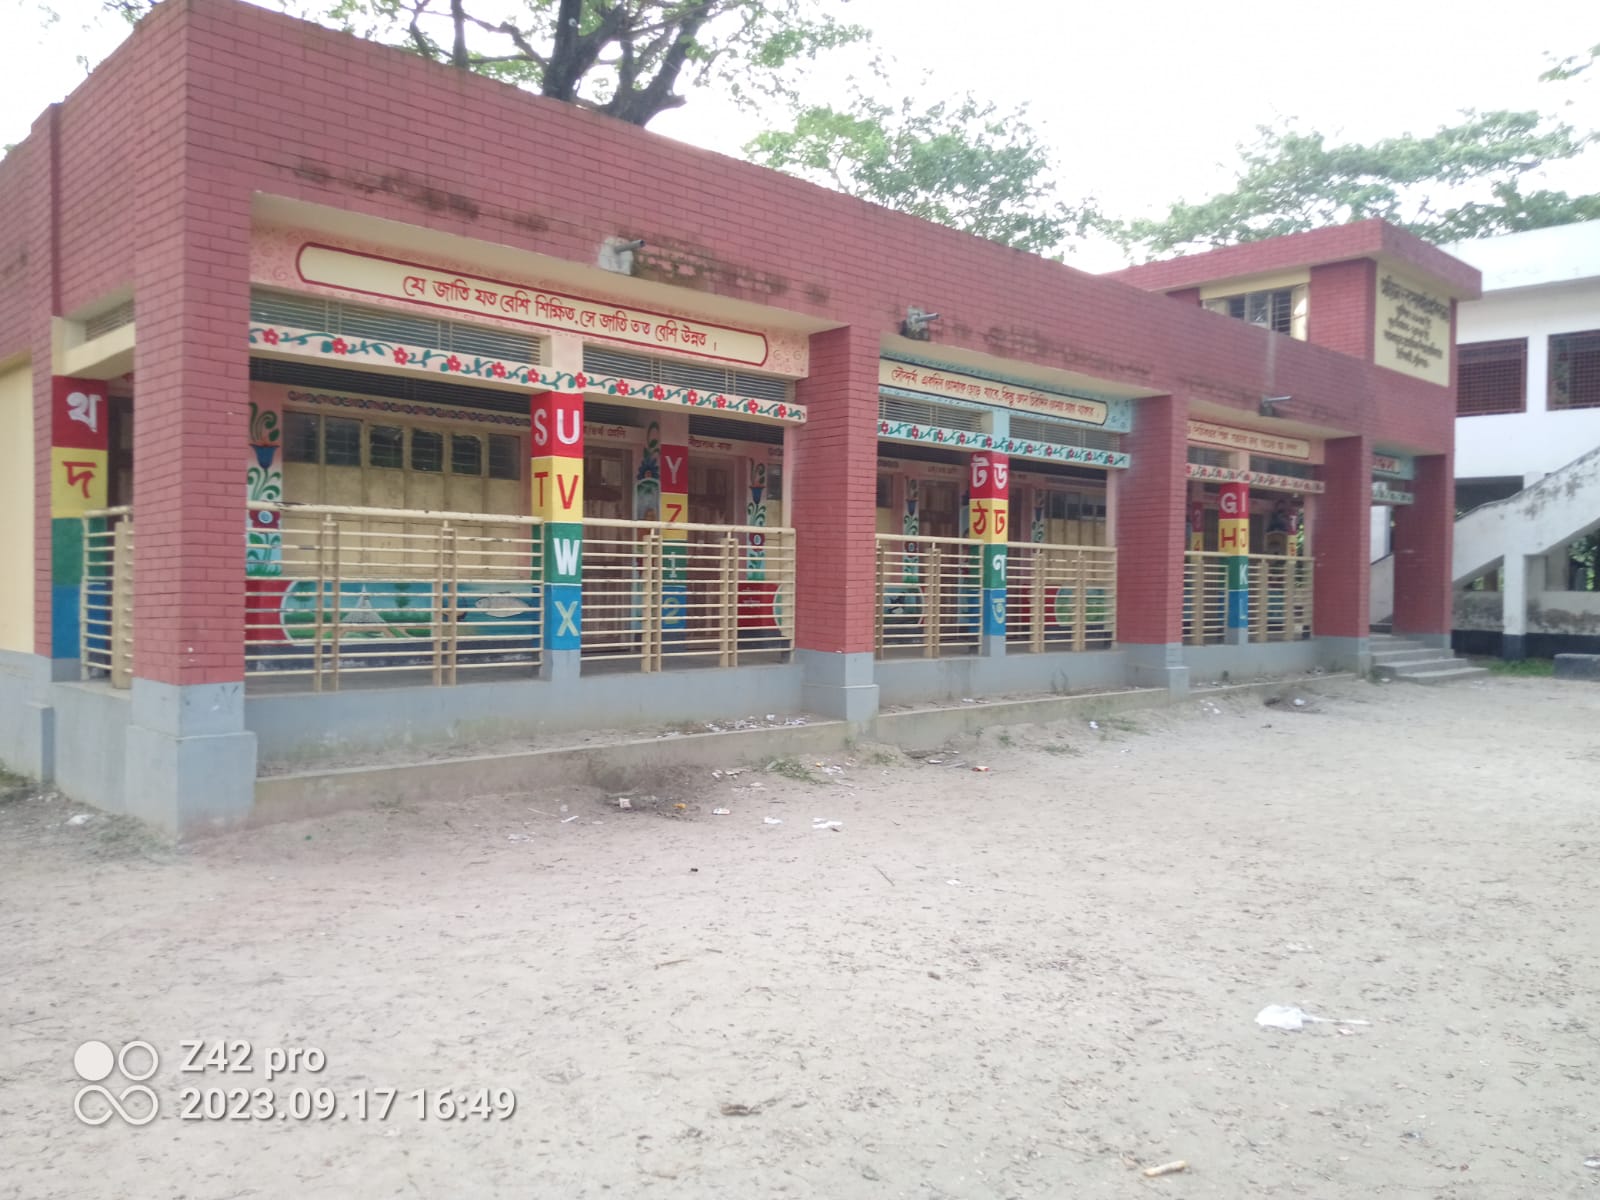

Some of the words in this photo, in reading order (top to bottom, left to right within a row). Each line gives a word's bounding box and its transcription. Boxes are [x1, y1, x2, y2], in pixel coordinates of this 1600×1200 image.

[403, 275, 427, 297] যে
[432, 278, 470, 303] জাতি
[474, 287, 499, 307] যত
[500, 290, 532, 316] বেশি
[580, 309, 597, 329] সে
[600, 310, 629, 334] জাতি
[630, 319, 651, 336] তত
[655, 319, 679, 343] বেশি
[681, 324, 708, 347] উন্নত
[66, 391, 104, 433] থ
[556, 408, 580, 445] U
[62, 459, 98, 499] দ
[664, 455, 683, 484] Y
[556, 473, 579, 510] V
[553, 537, 581, 576] W
[554, 600, 580, 637] X
